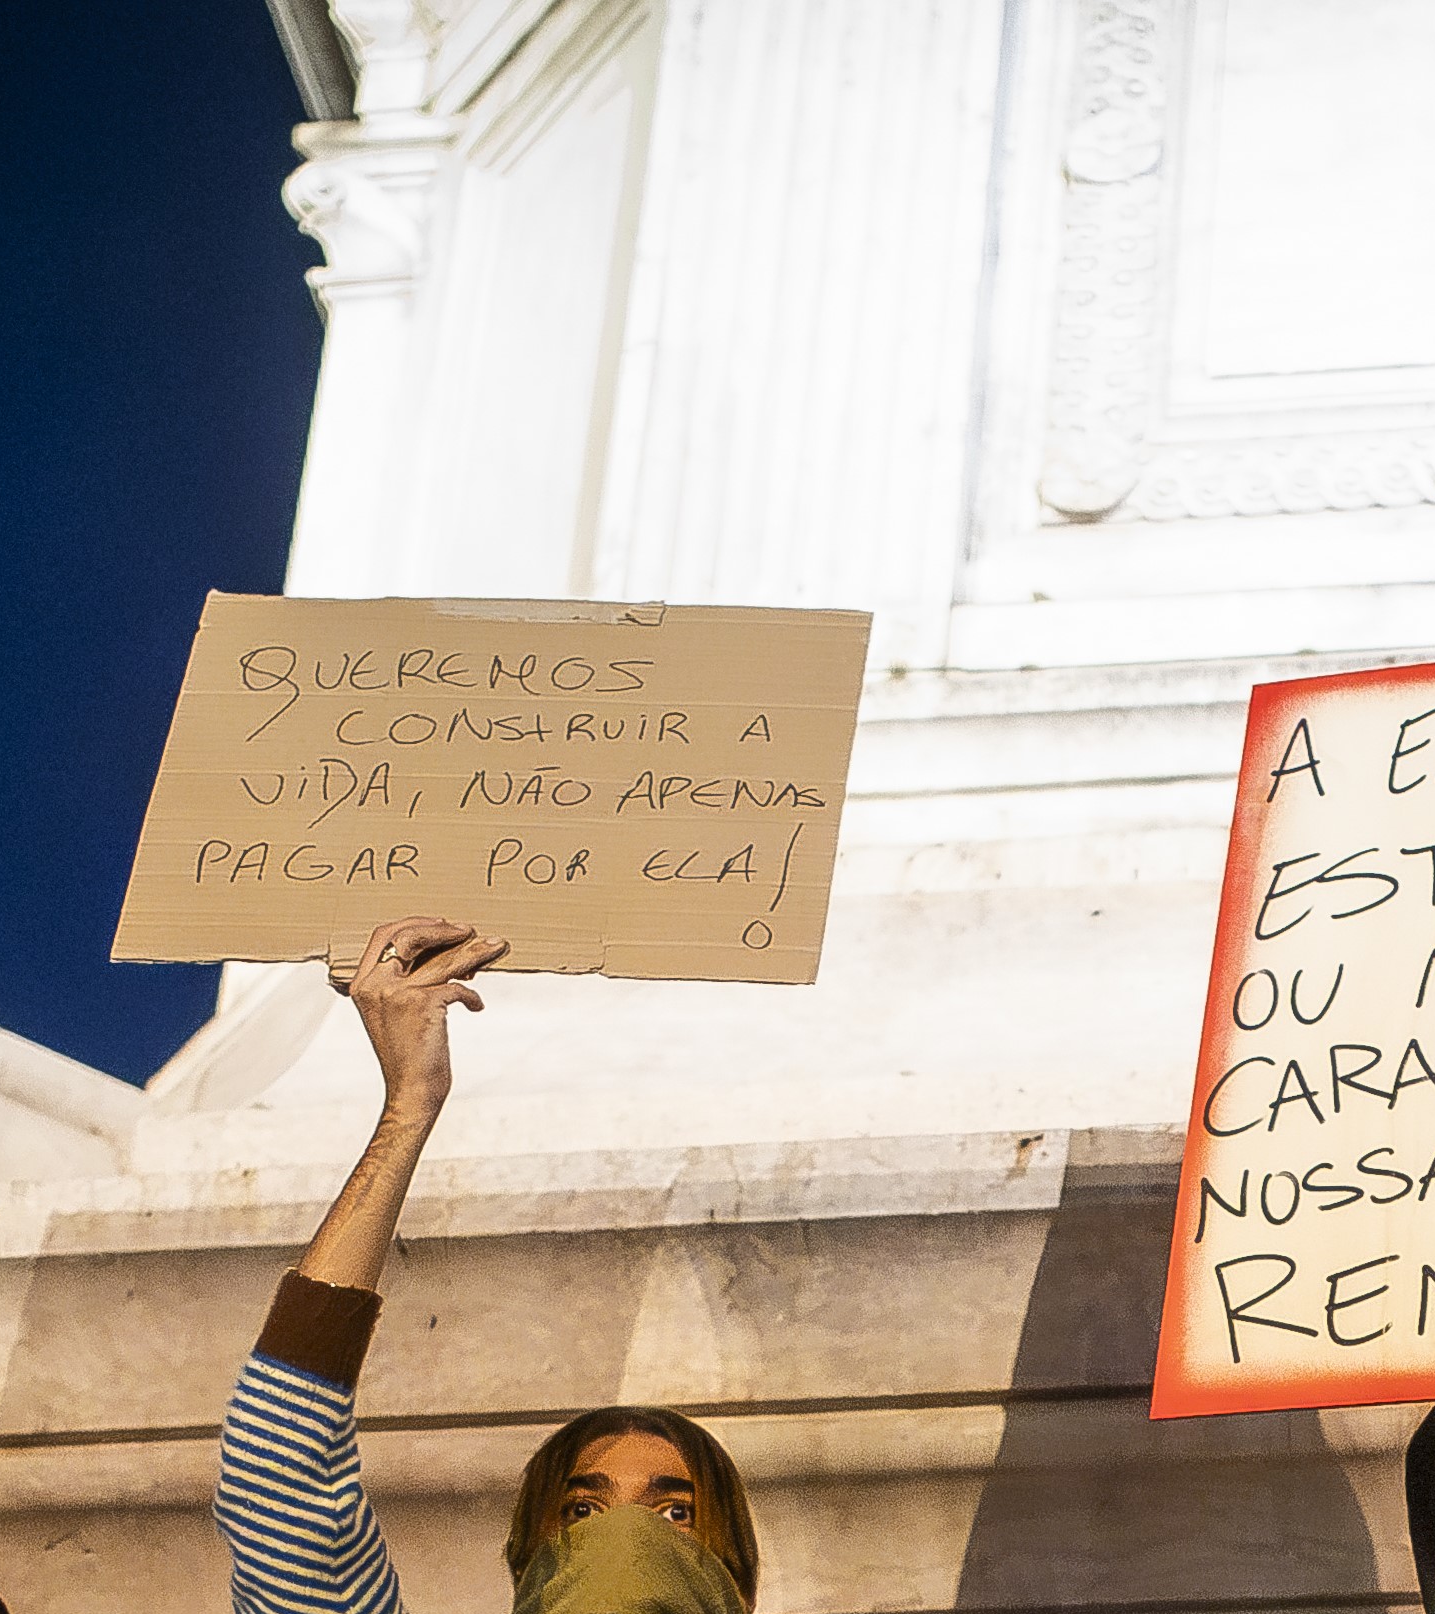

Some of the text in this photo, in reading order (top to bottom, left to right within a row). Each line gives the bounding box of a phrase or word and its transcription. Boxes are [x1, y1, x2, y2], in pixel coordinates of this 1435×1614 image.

[239, 646, 654, 741] QUEREMOS
[739, 714, 771, 742] A
[1267, 718, 1325, 803] A
[461, 766, 592, 808] NÃO
[617, 771, 826, 814] APENAS
[196, 840, 422, 885] PAGAR
[487, 839, 590, 886] POR
[1233, 964, 1344, 1030] OU
